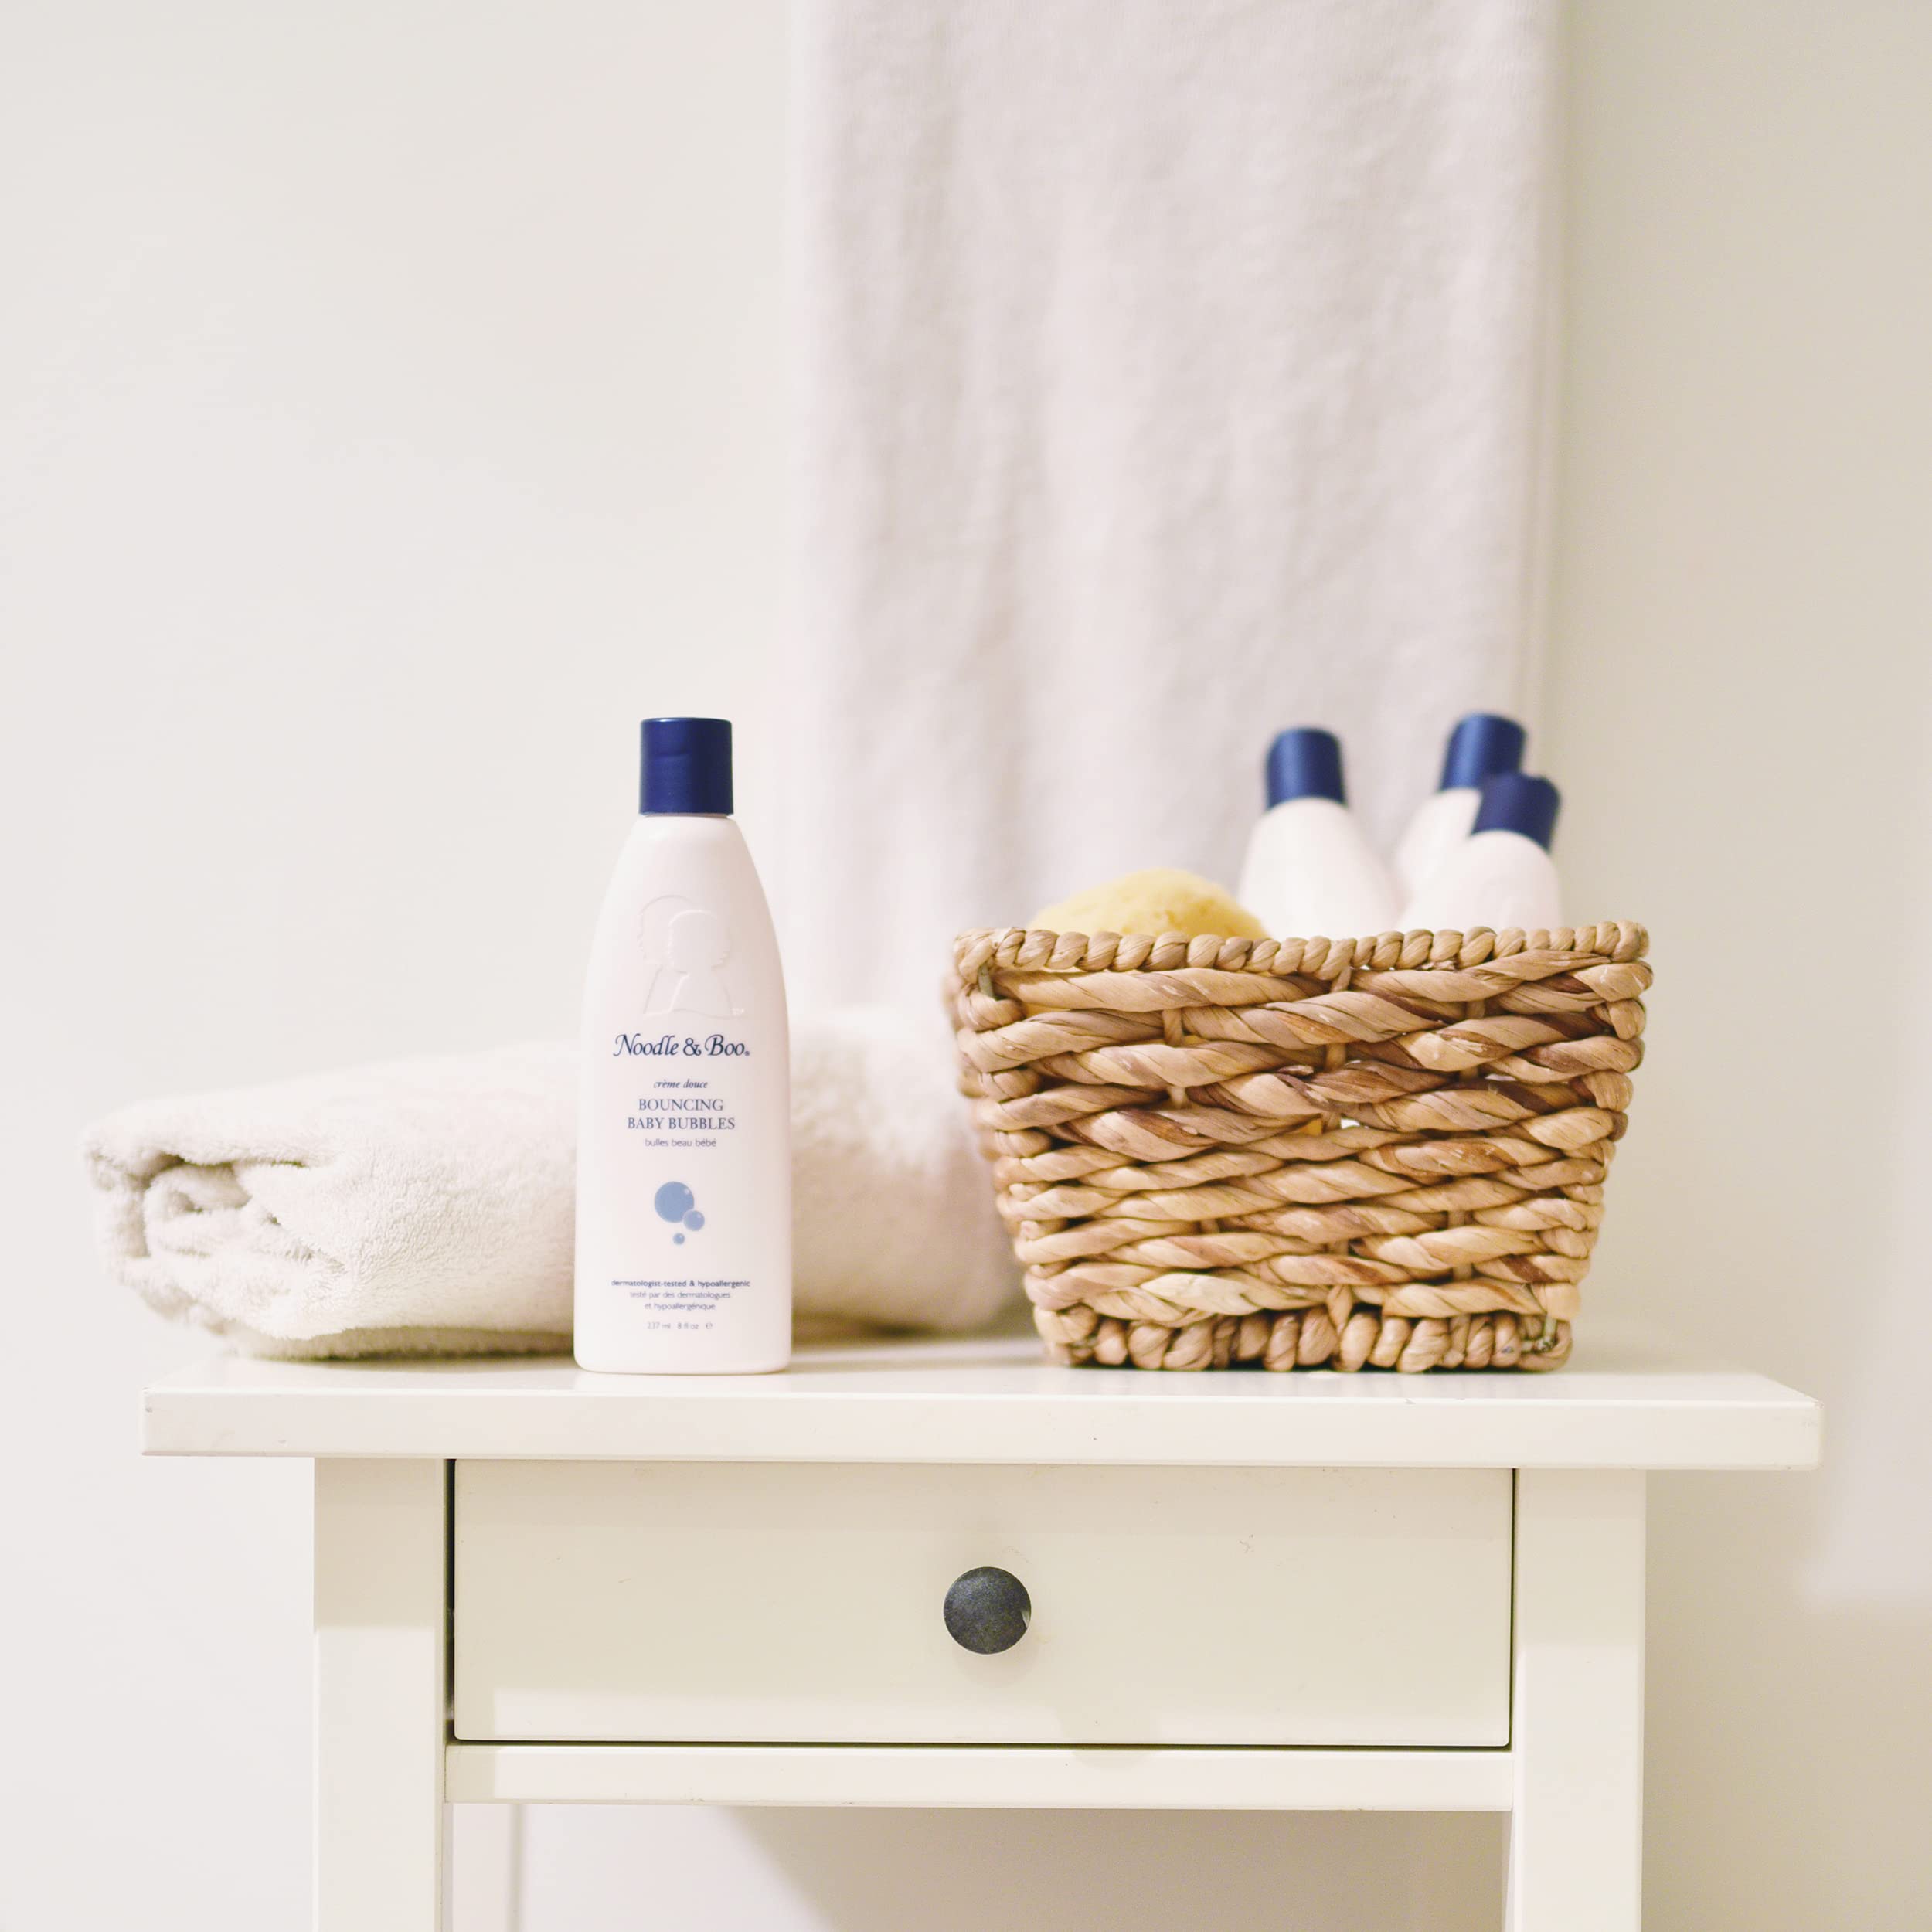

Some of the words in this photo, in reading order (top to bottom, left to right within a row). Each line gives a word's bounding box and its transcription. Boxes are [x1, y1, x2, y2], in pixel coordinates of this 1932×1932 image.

[613, 1033, 679, 1056] Noodle
[682, 1037, 702, 1056] &
[654, 1079, 680, 1088] crème
[683, 1078, 709, 1088] douce
[638, 1098, 724, 1111] BOUNCING
[628, 1117, 665, 1130] BABY
[668, 1117, 736, 1130] BUBBLES
[645, 1138, 669, 1147] bulles
[671, 1138, 692, 1147] beau
[695, 1138, 717, 1147] bébé
[611, 1280, 687, 1288] dermatologist-tested
[697, 1280, 750, 1288] hypoallergenic
[677, 1291, 731, 1301] dermatologues
